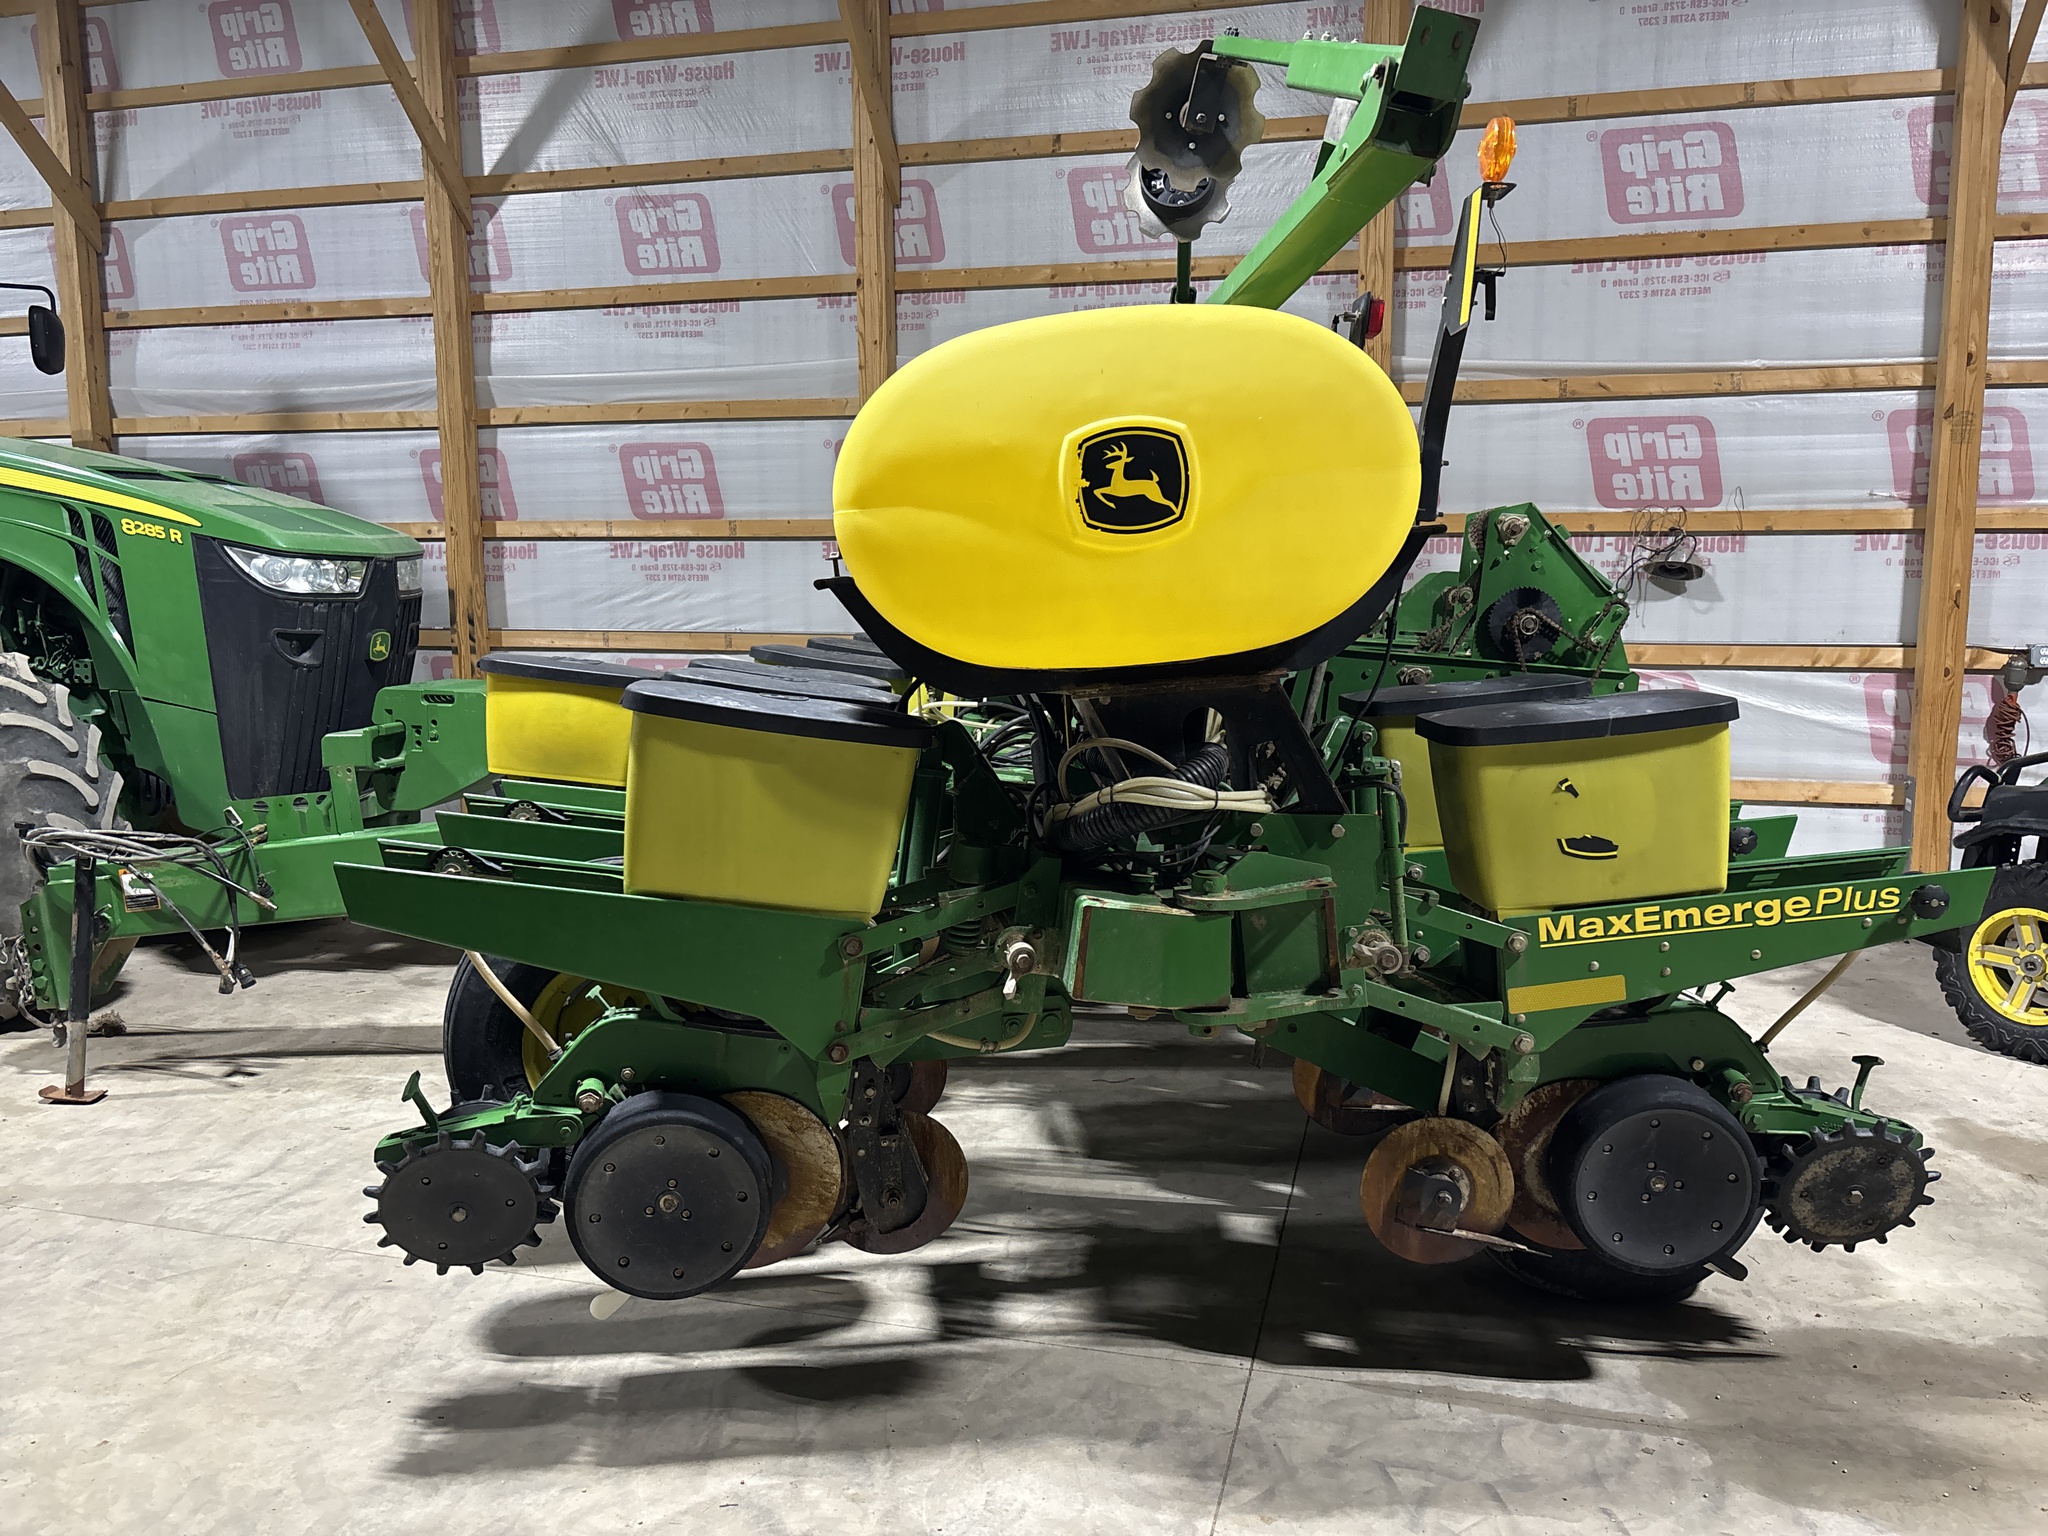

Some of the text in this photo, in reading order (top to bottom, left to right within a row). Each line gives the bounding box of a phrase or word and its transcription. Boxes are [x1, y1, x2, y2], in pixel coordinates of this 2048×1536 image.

[120, 518, 184, 545] 8285 R
[1538, 886, 1901, 941] MaxEmergePlus
